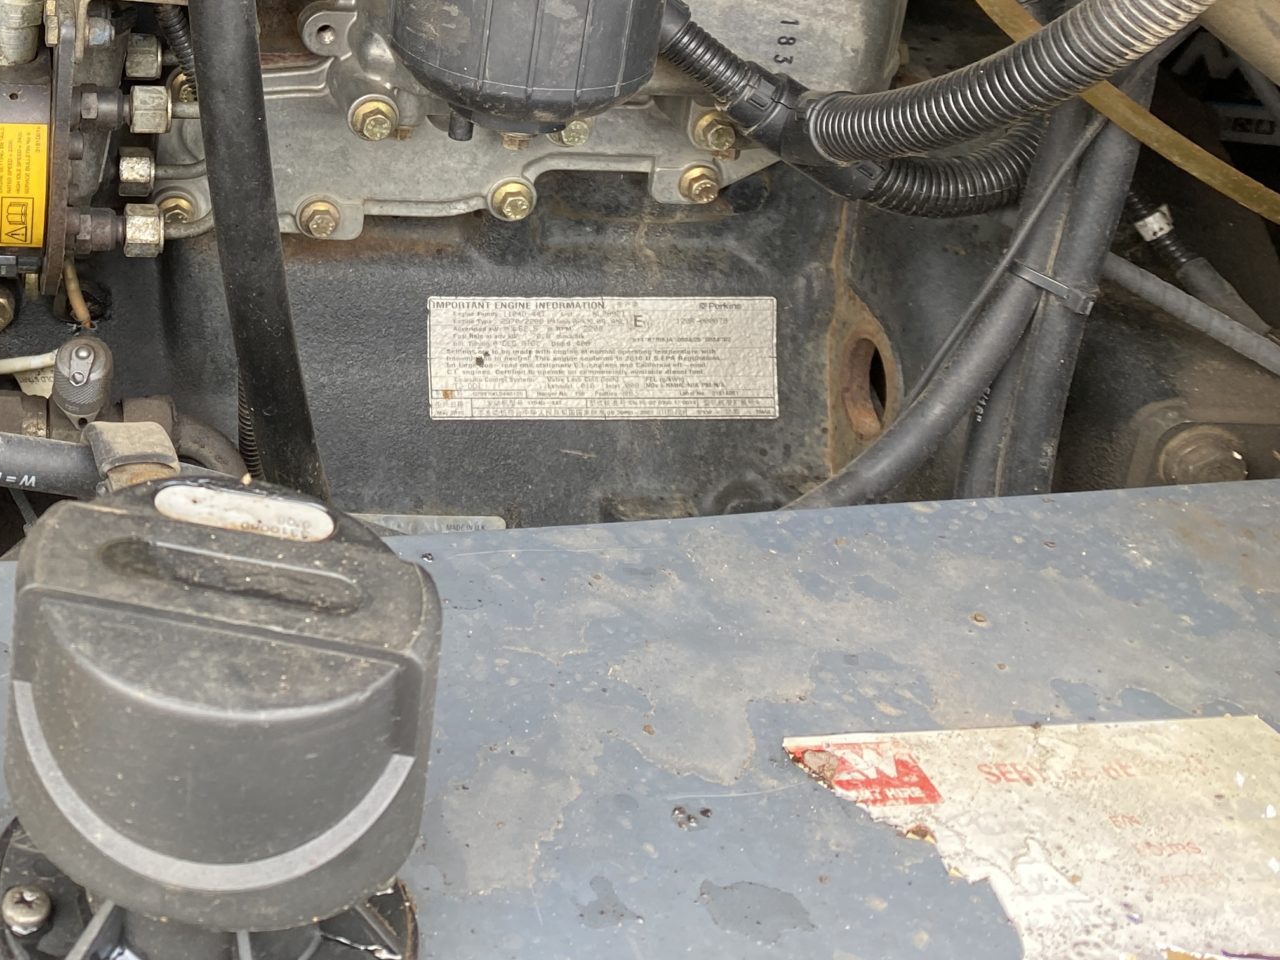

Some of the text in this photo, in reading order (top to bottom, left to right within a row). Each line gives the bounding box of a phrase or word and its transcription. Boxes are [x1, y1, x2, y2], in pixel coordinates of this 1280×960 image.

[773, 19, 800, 65] 183
[432, 301, 605, 309] IMPORTANT ENGINE INFORMATION
[708, 302, 741, 310] Perkins
[633, 315, 643, 327] E
[18, 474, 37, 488] W
